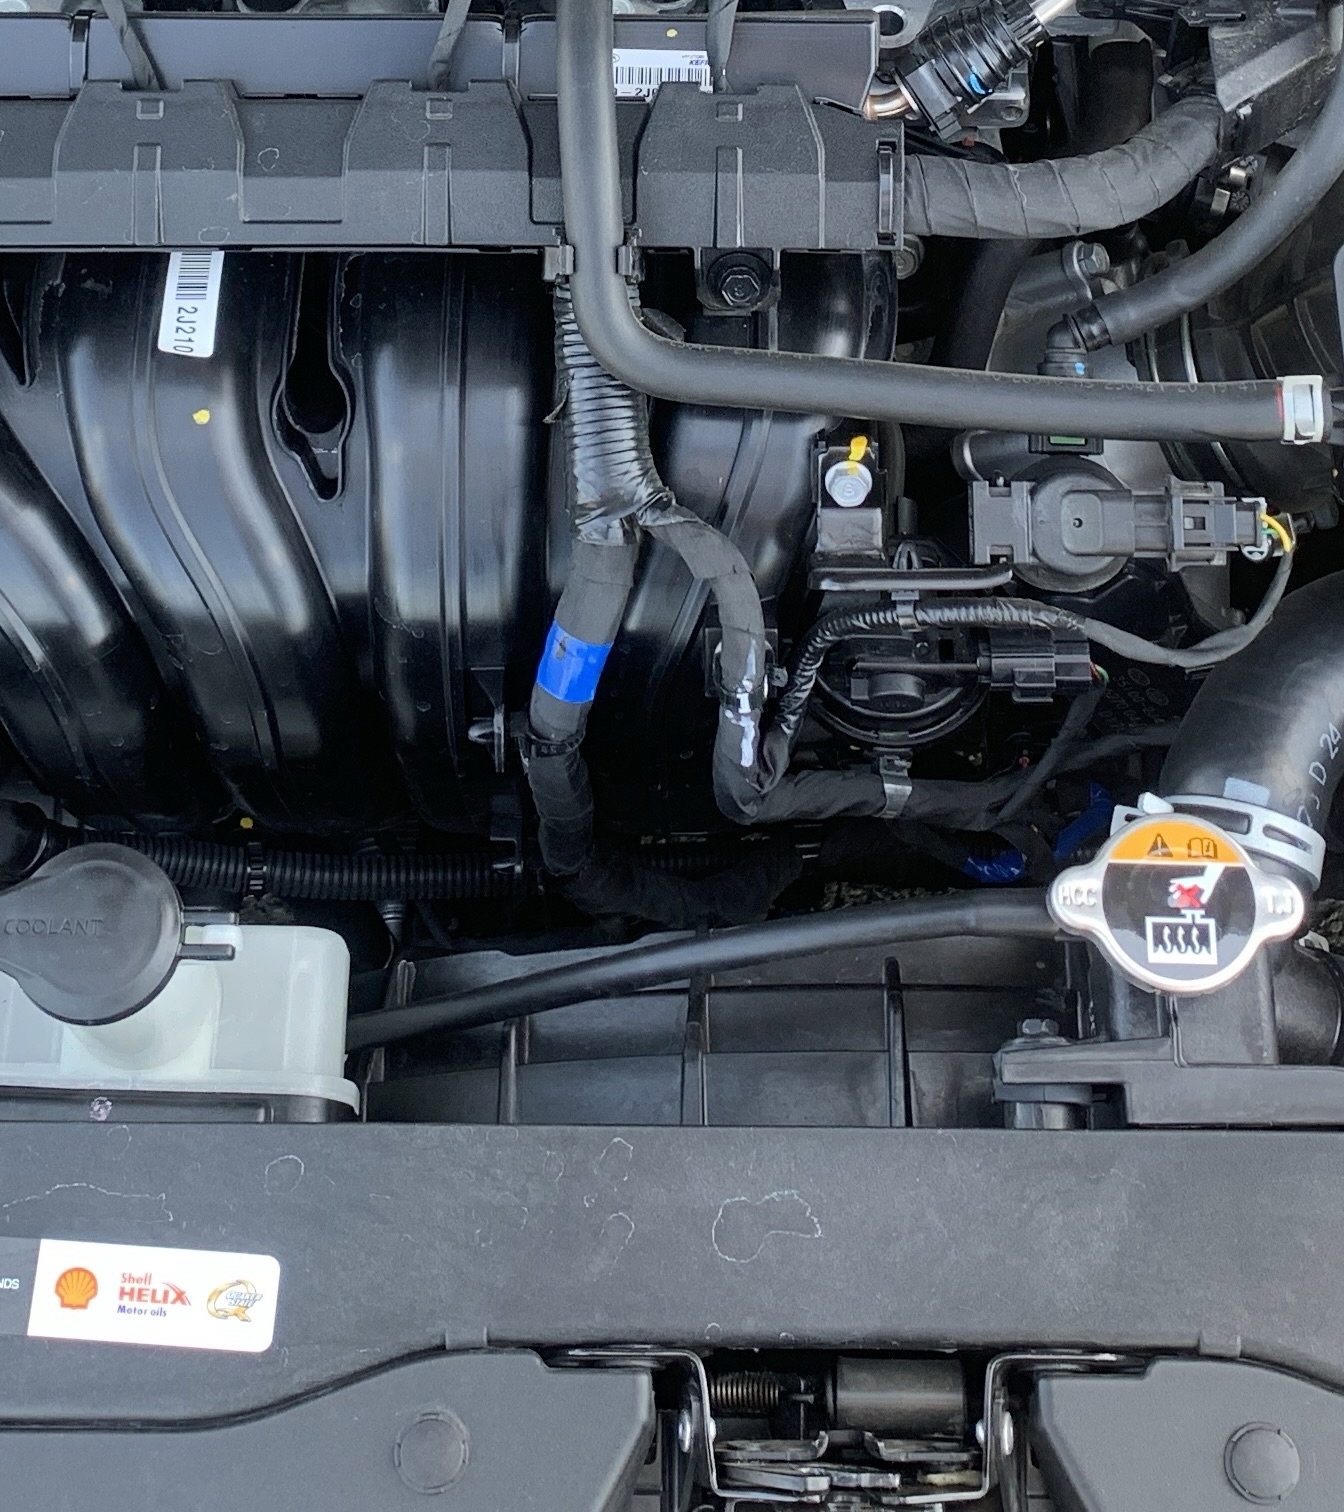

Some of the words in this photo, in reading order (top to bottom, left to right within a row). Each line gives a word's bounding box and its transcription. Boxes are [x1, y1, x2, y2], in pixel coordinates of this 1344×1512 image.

[173, 306, 198, 353] 2J210
[1057, 884, 1098, 907] HCC
[3, 918, 105, 936] COOLANT
[121, 1272, 152, 1286] Shell
[119, 1285, 189, 1306] HELIX
[117, 1304, 147, 1315] Motor
[150, 1307, 168, 1318] oils
